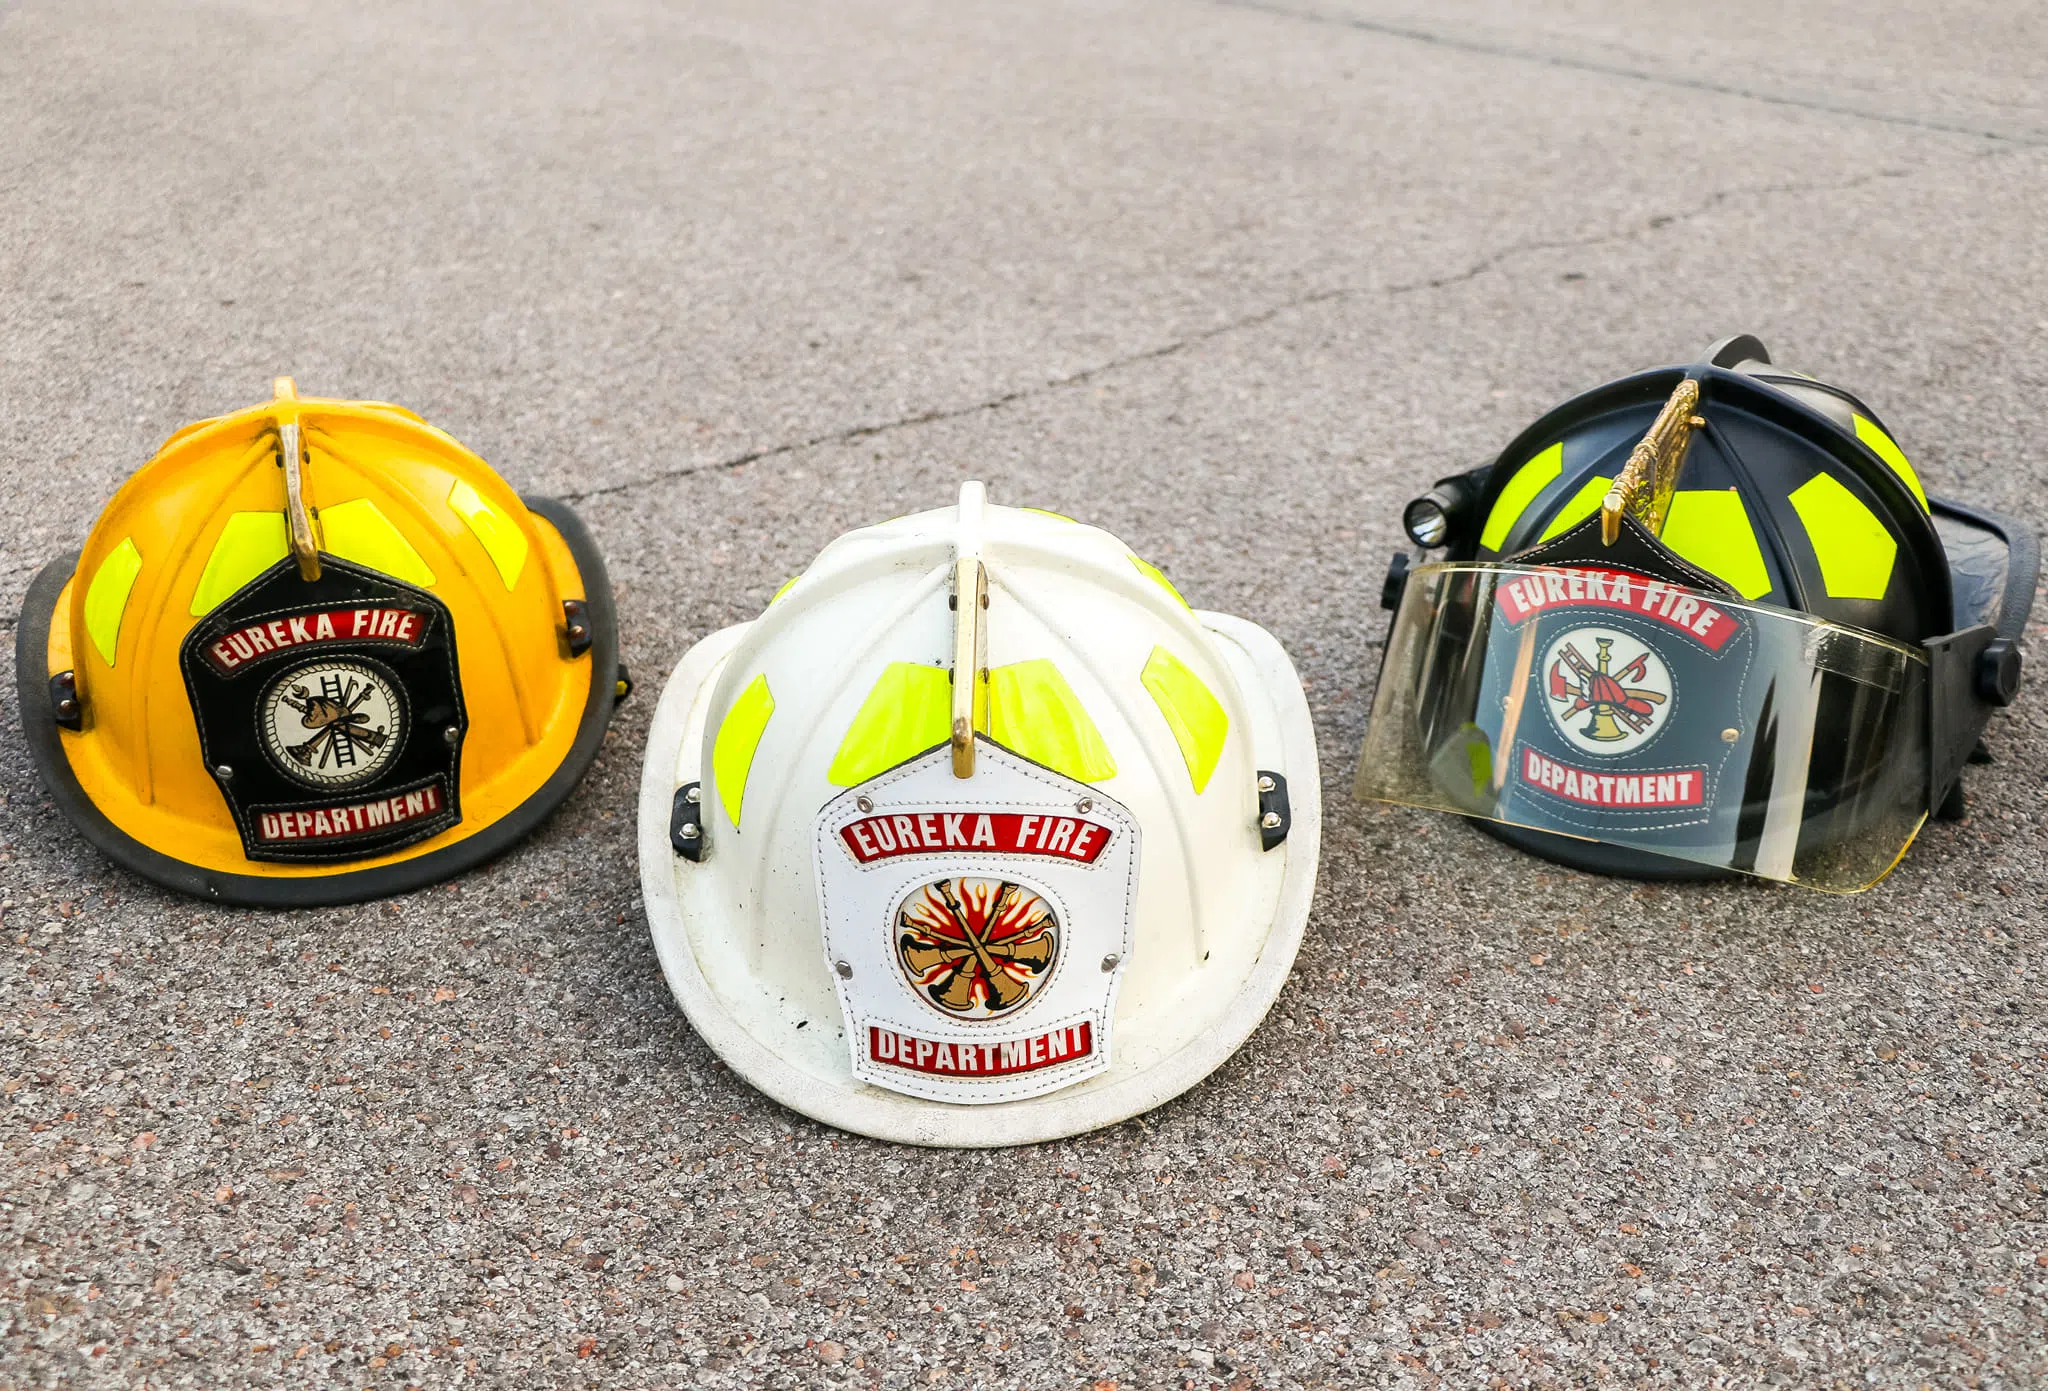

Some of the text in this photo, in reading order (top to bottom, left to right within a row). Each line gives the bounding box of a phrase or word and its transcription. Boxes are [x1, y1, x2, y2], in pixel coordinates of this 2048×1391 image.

[1508, 569, 1721, 637] EUREKA FIRE
[211, 609, 417, 669] EUREKA FIRE
[1528, 752, 1693, 804] DEPARTMENT
[261, 785, 439, 840] DEPARTMENT
[851, 813, 1099, 857] EUREKA FIRE
[878, 1022, 1084, 1071] DEPARTMENT
